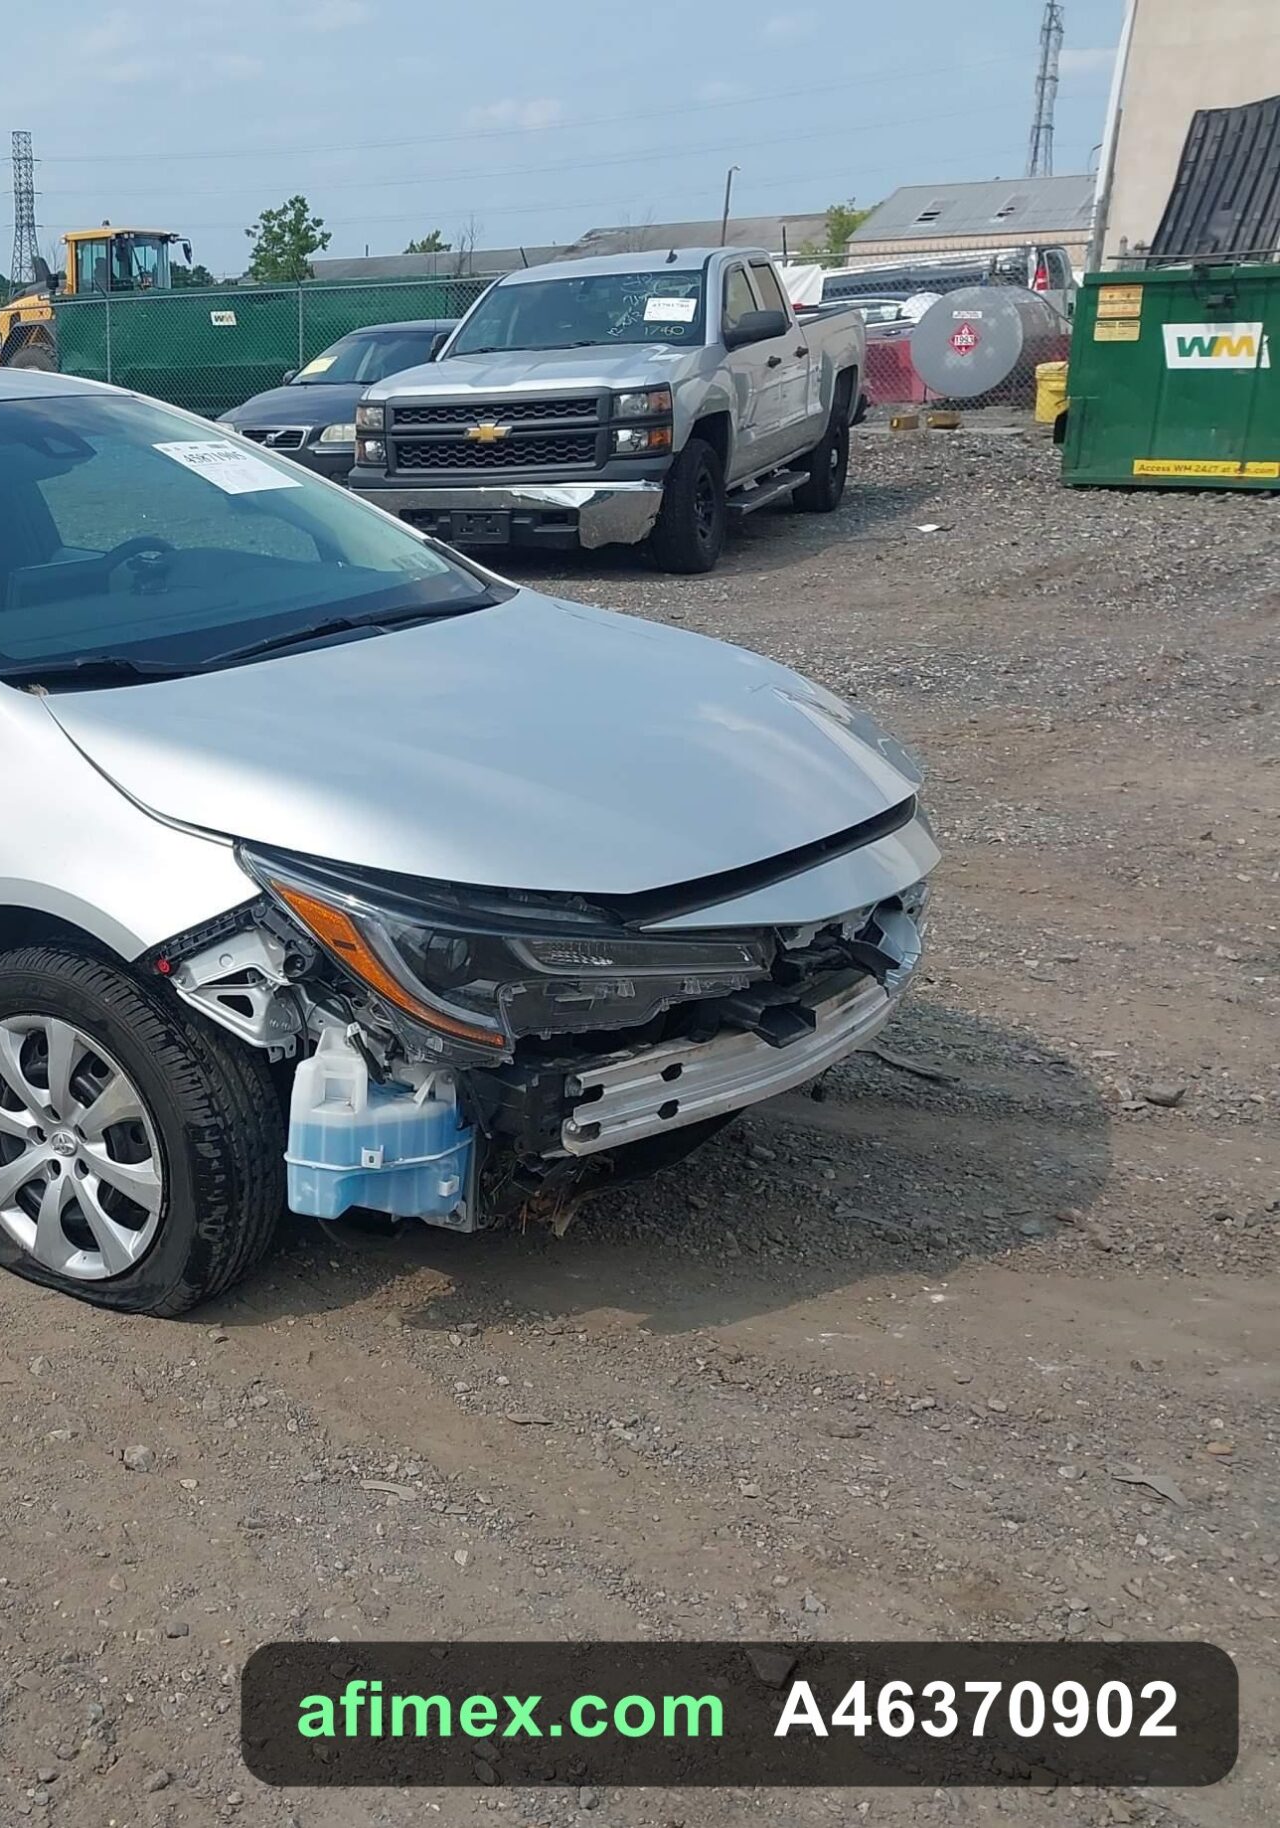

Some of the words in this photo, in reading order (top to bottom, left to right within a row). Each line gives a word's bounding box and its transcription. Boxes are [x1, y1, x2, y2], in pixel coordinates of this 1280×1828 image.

[1176, 336, 1255, 357] WM
[1140, 464, 1171, 473] Access
[1174, 464, 1193, 472] WM
